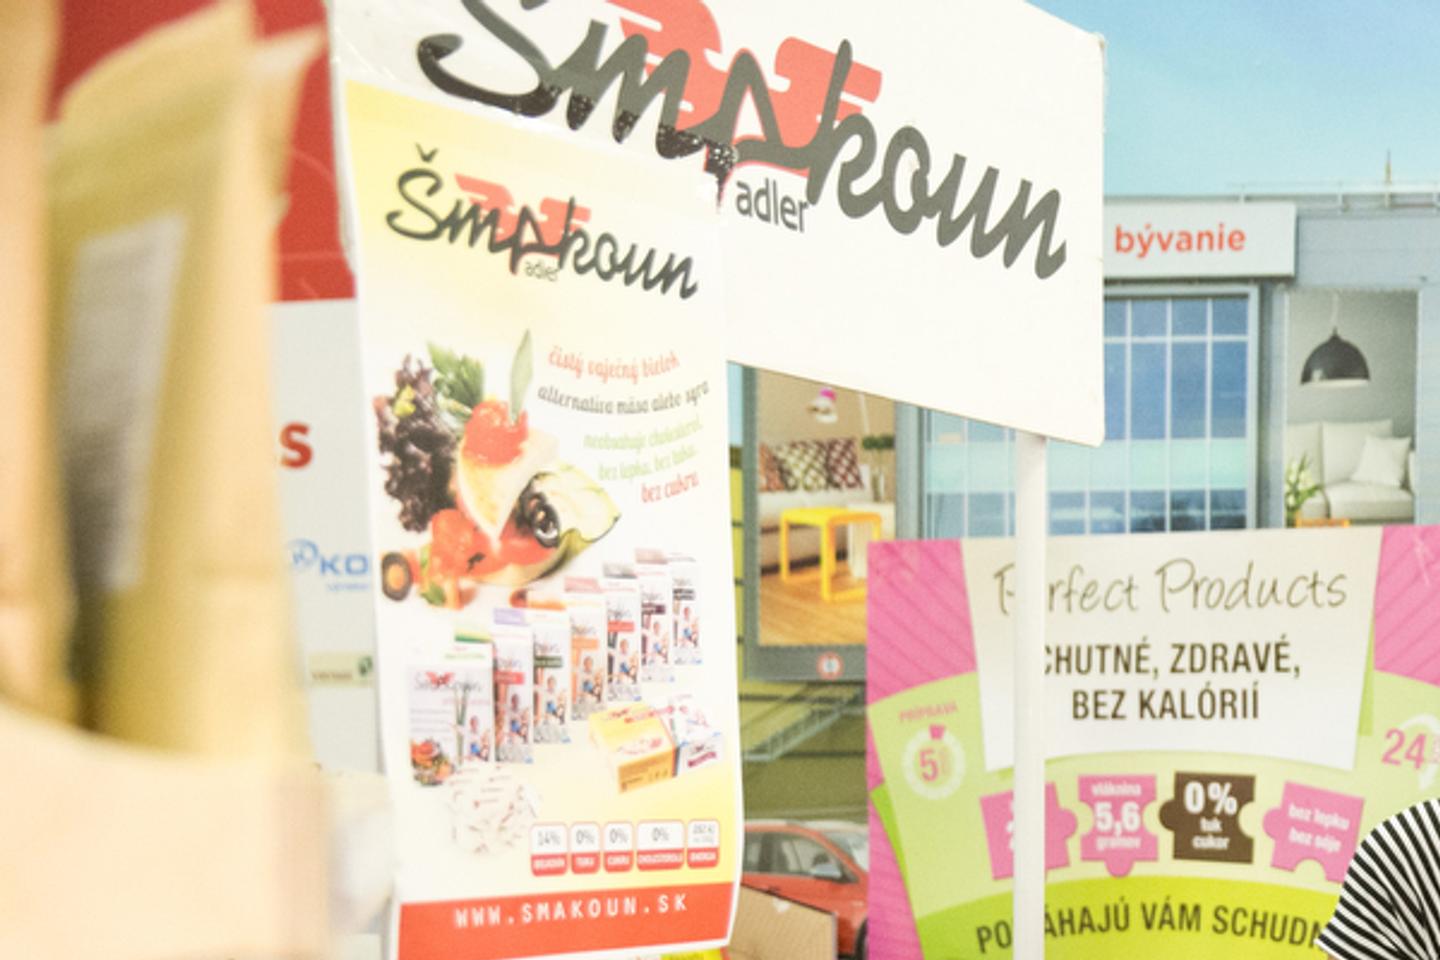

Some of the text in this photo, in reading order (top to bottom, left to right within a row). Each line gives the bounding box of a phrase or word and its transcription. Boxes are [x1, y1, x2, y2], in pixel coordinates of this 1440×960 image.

[736, 178, 808, 233] adler
[1115, 223, 1247, 259] bývanie
[640, 483, 662, 503] bez
[993, 558, 1348, 616] Prfect Products
[1169, 634, 1301, 679] ZDRAVÉ,
[1072, 680, 1260, 721] BEZ KALÓRIÍ
[919, 748, 939, 782] 5
[1381, 728, 1427, 770] 24
[1094, 801, 1141, 837] 5,6
[1200, 817, 1222, 832] tuk
[1288, 803, 1313, 821] bez
[1192, 834, 1231, 851] cukor
[1288, 827, 1312, 847] bez
[454, 894, 688, 928] WWW.SMAKOUN.SK
[977, 896, 1130, 954] POÁHAJÚ
[1141, 895, 1202, 932] VÁM
